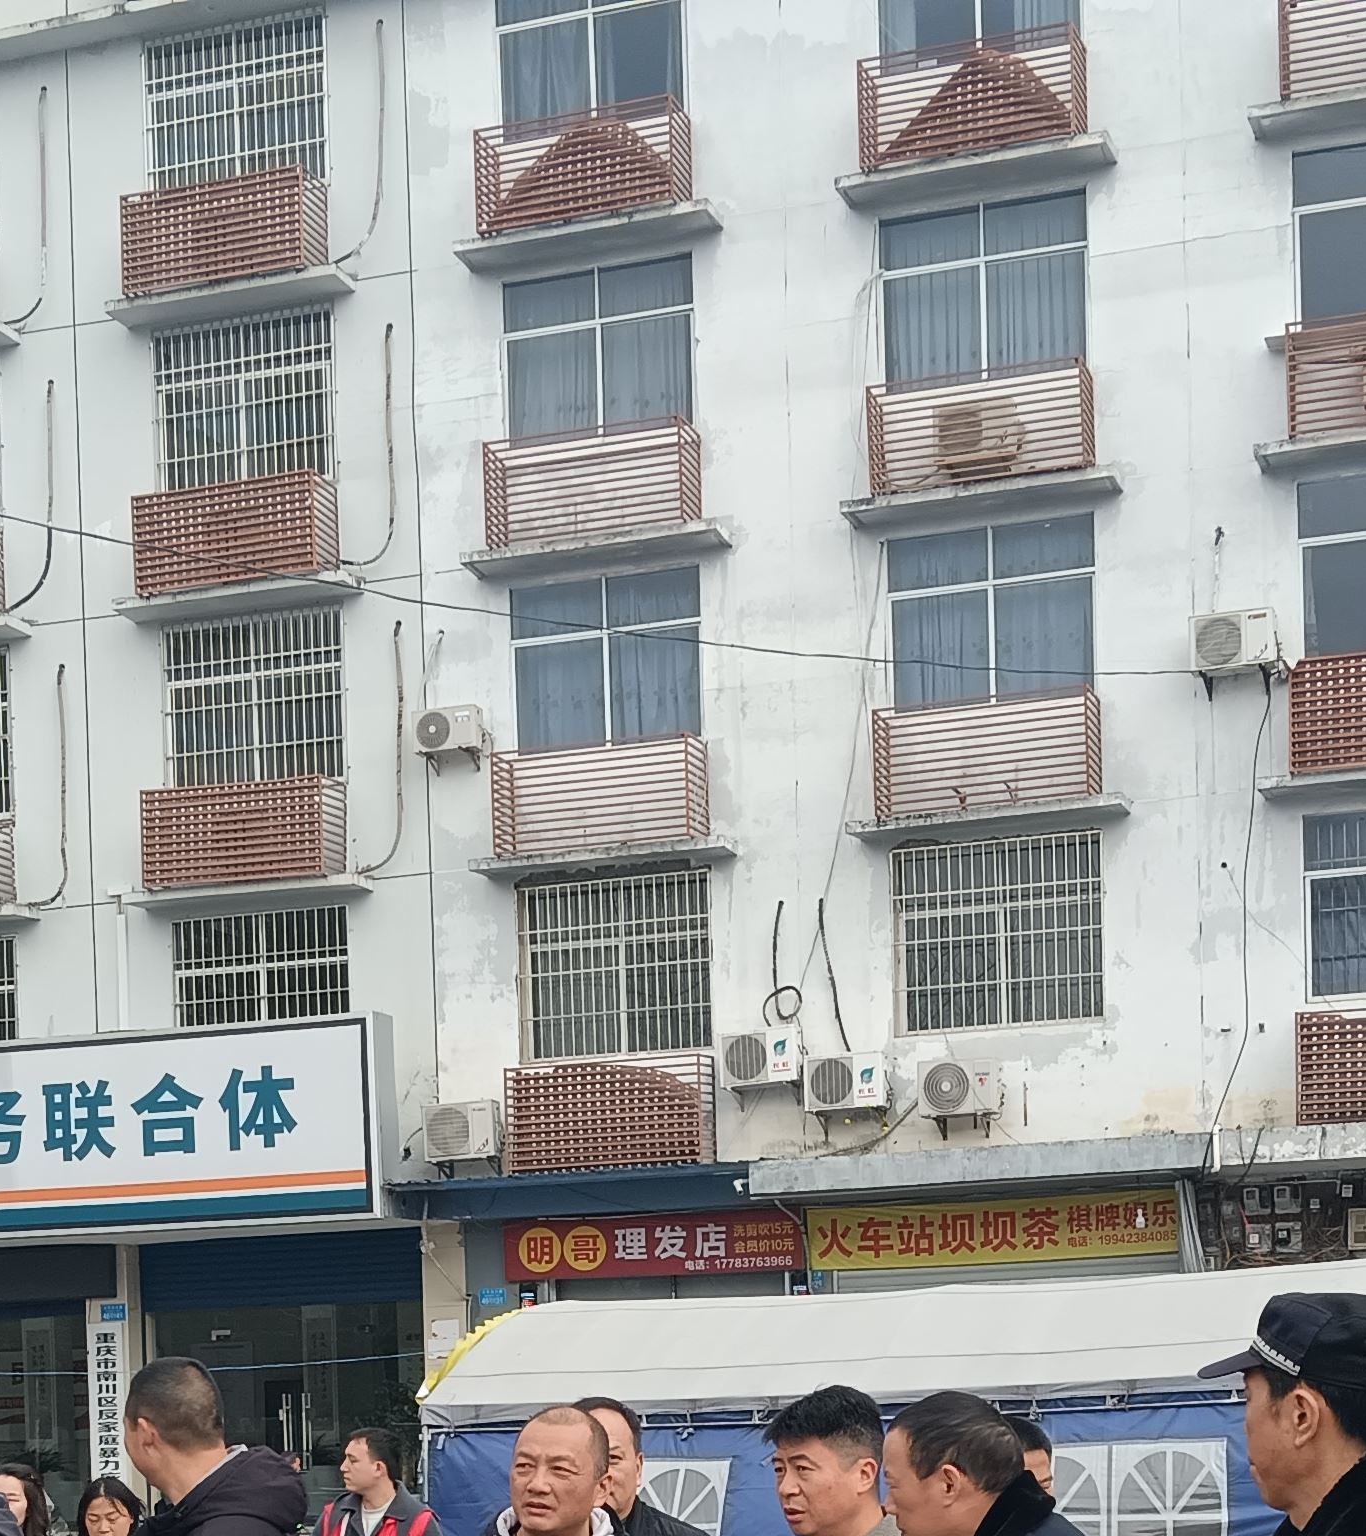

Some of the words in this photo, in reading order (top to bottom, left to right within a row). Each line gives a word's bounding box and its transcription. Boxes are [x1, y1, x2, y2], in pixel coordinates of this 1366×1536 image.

[734, 1239, 795, 1253] 会员价10元
[817, 1207, 1060, 1259] 火车站坝坝茶
